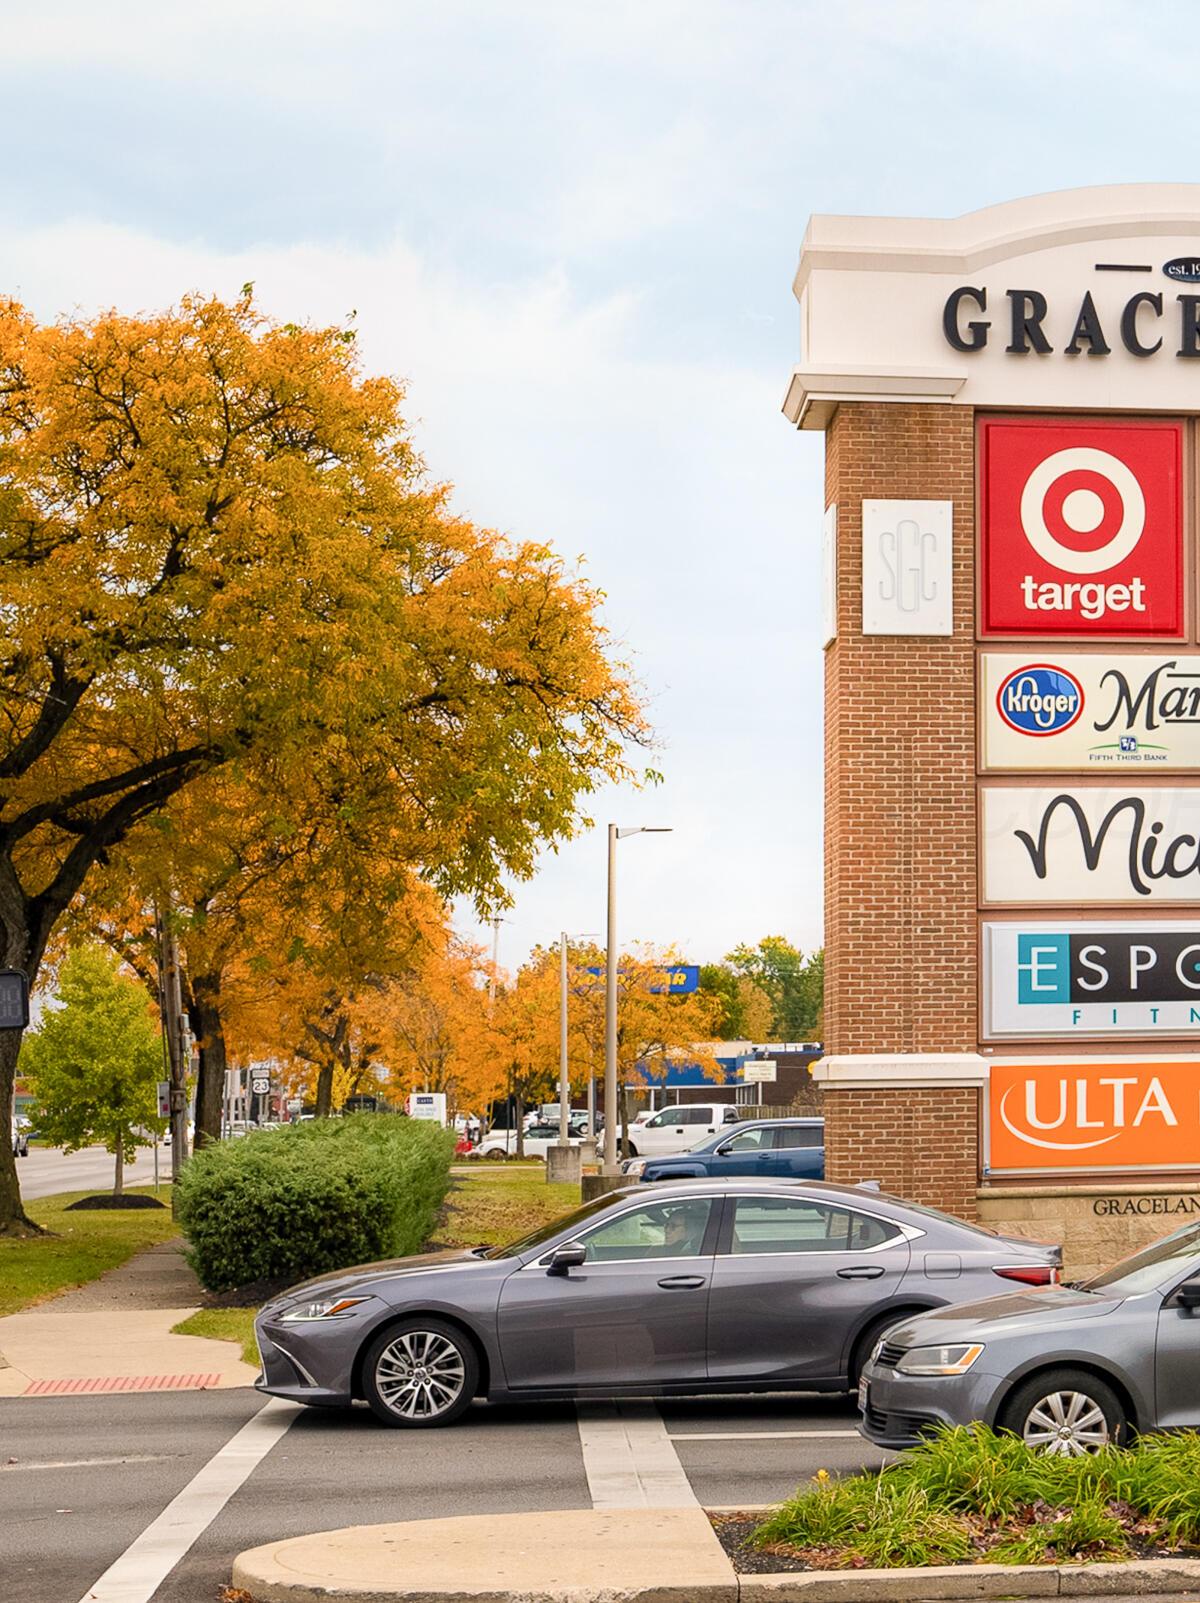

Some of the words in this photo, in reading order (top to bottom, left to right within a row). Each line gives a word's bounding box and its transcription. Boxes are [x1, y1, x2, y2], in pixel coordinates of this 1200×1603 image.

[1168, 265, 1188, 275] est.
[1020, 575, 1146, 620] target
[1007, 676, 1078, 728] Kroger
[254, 1081, 268, 1091] 23
[1025, 1077, 1179, 1130] ULTA
